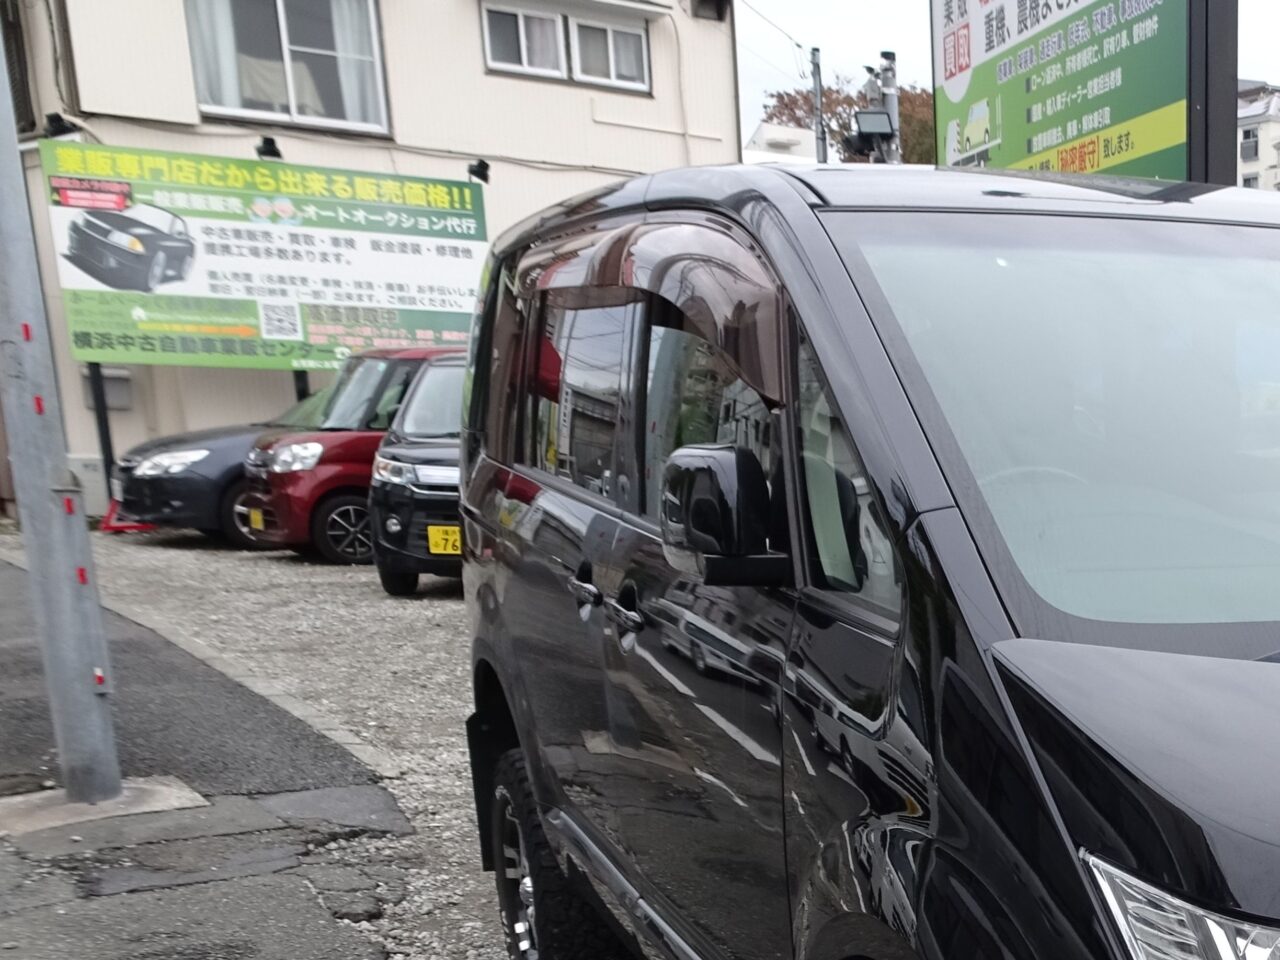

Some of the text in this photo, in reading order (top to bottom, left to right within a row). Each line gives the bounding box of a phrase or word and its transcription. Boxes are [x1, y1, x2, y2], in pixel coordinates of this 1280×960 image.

[944, 23, 970, 80] 買取
[302, 204, 478, 235] オートオークション代行
